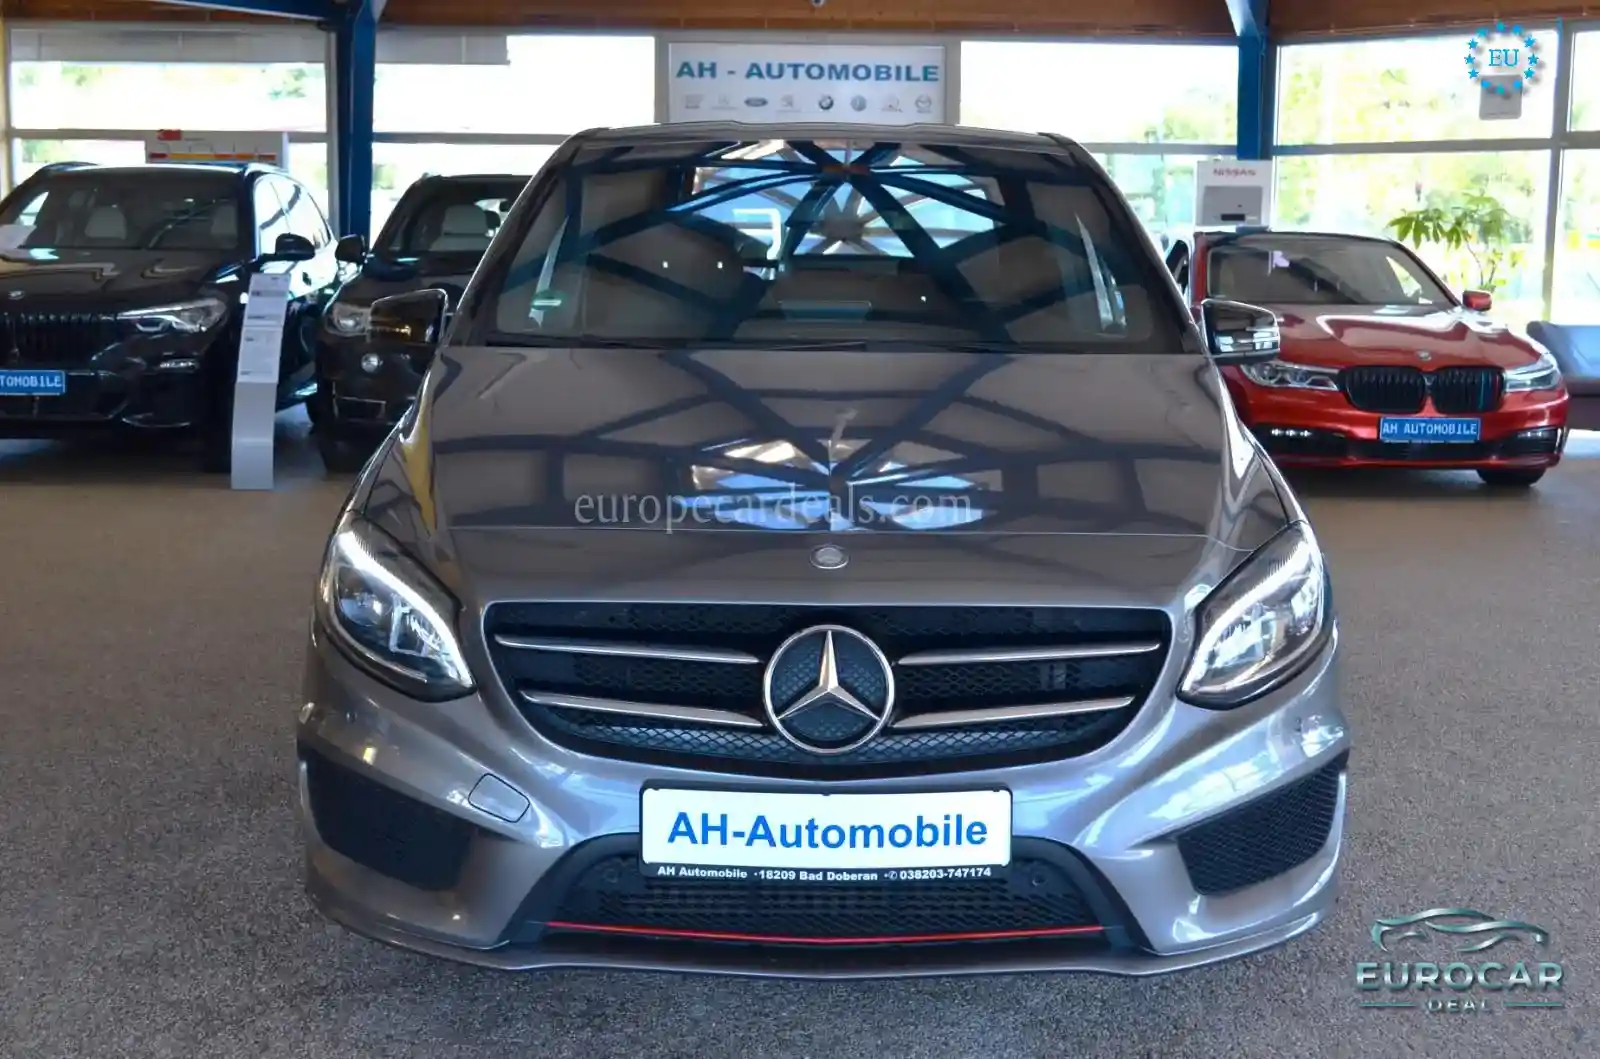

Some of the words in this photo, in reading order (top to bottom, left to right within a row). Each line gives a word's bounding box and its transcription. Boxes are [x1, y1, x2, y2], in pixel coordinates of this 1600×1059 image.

[675, 61, 718, 79] AH
[744, 62, 940, 82] AUTOMOBILE
[1382, 422, 1398, 434] AH
[1403, 422, 1478, 435] AUTOMOBILE
[667, 811, 988, 849] AH-Automobile
[657, 866, 676, 876] AH
[679, 867, 748, 879] Automobile
[799, 871, 823, 881] Bad
[826, 871, 878, 881] Doberan
[899, 867, 992, 880] 038203-747174
